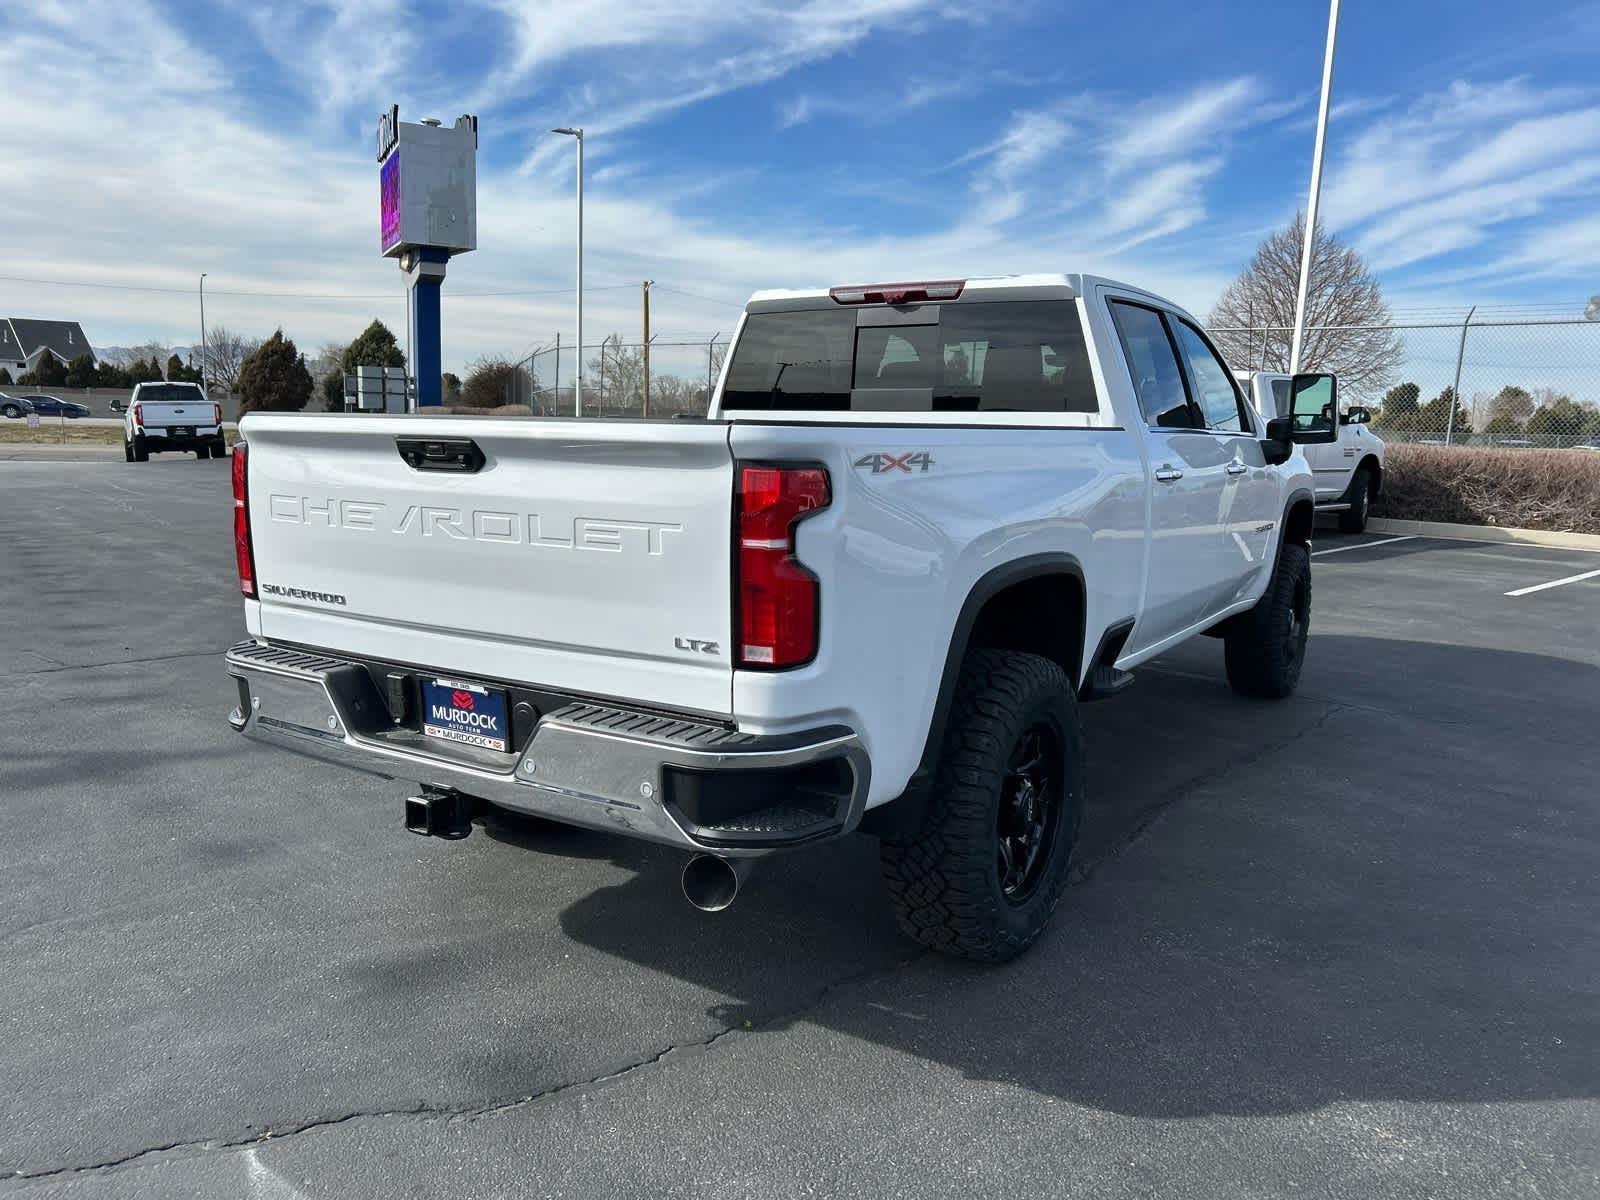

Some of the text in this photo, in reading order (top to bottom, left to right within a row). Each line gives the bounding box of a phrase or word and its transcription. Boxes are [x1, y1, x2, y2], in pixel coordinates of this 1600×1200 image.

[270, 494, 683, 555] CHEVROLET
[262, 583, 346, 605] SILVERADO
[674, 637, 720, 655] LTZ
[432, 704, 498, 731] MURDOCK
[442, 730, 487, 746] MURDOCK
